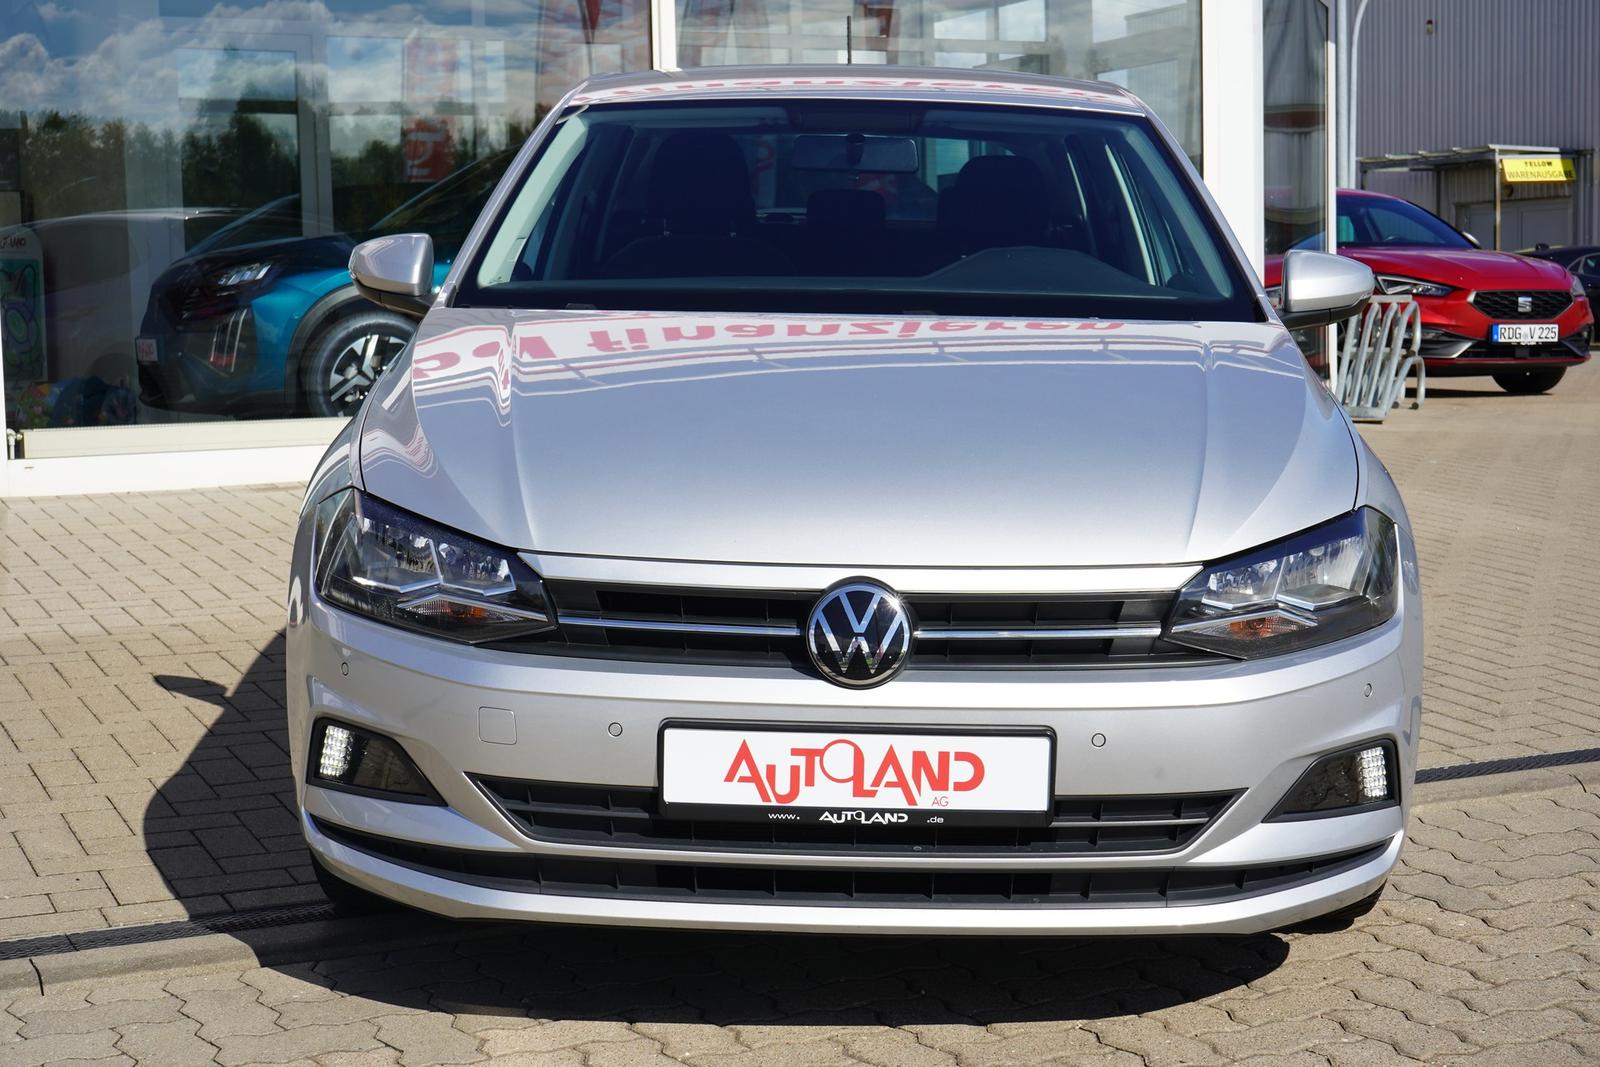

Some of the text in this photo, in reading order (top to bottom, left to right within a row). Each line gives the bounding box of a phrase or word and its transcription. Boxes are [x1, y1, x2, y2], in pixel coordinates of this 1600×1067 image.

[1499, 326, 1557, 340] RDG V 225
[723, 738, 985, 806] AUTOLAND
[931, 796, 949, 807] AG
[767, 810, 944, 824] www. AUTOLAND .de
